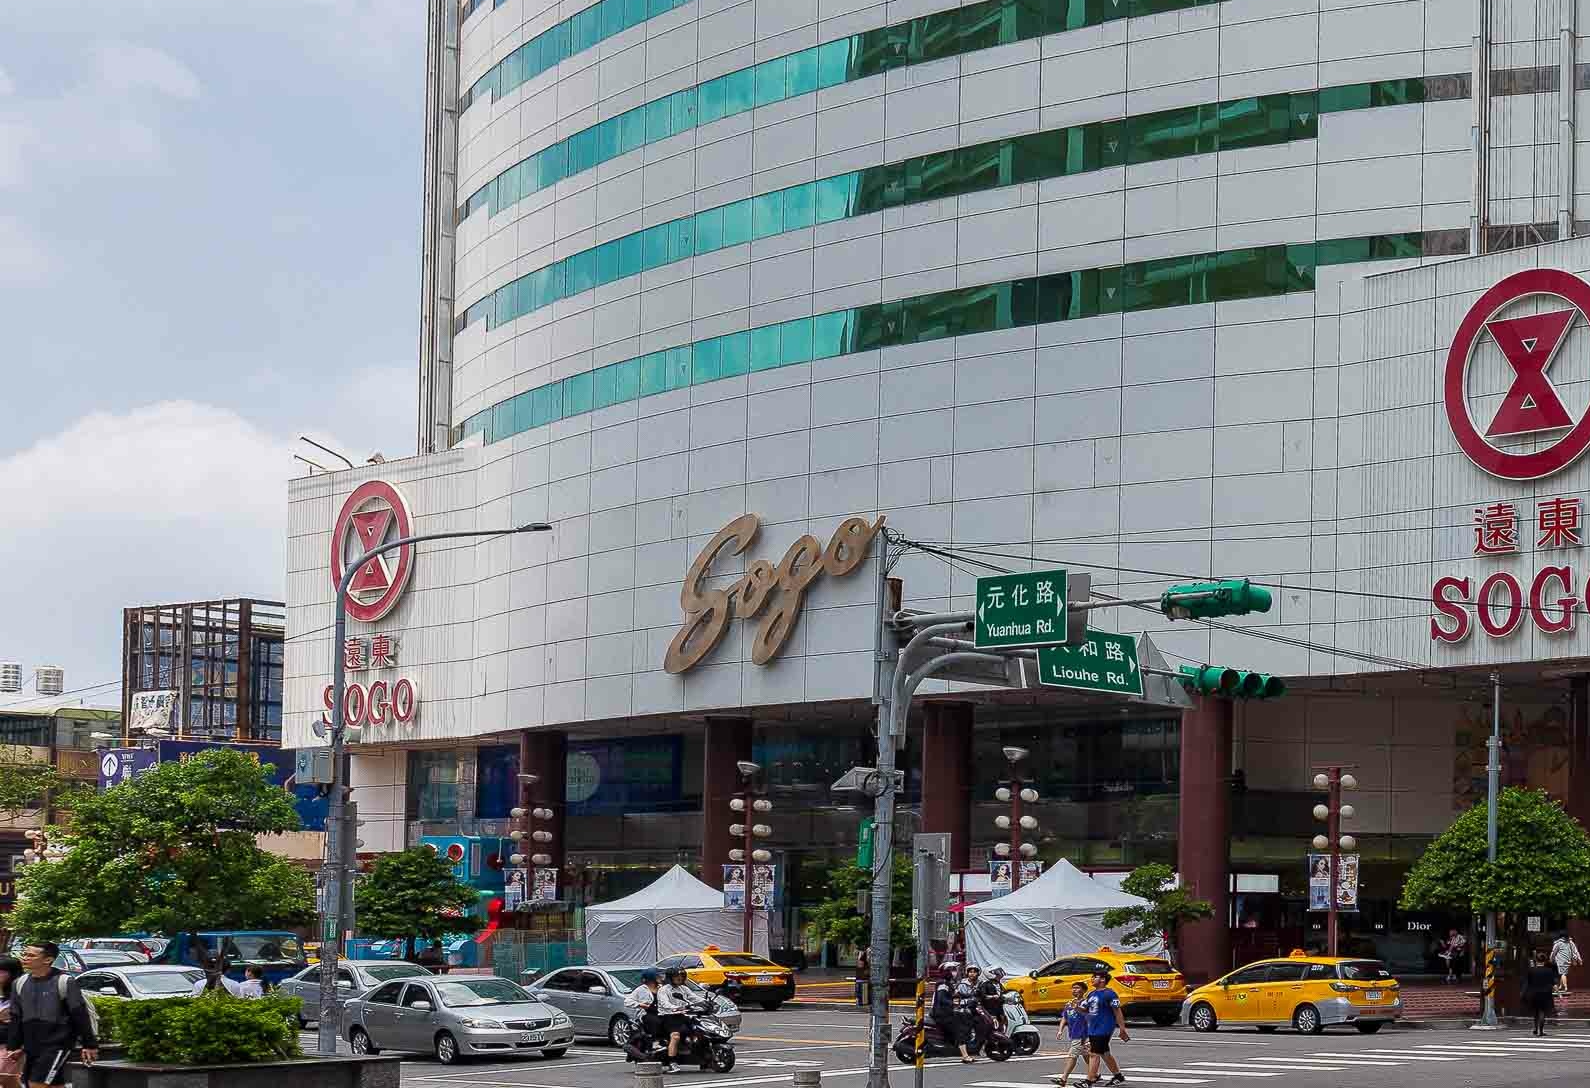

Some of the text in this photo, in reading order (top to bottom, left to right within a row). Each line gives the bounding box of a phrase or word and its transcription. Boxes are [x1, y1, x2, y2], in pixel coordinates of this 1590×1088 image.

[1473, 497, 1582, 555] 遠東
[664, 512, 886, 674] Sogo
[987, 580, 1055, 609] 元化路
[986, 618, 1055, 638] Yuanhua Rd.
[343, 634, 393, 670] 遠東
[1052, 664, 1129, 686] Liouhe Rd.
[1407, 921, 1432, 930] Dior
